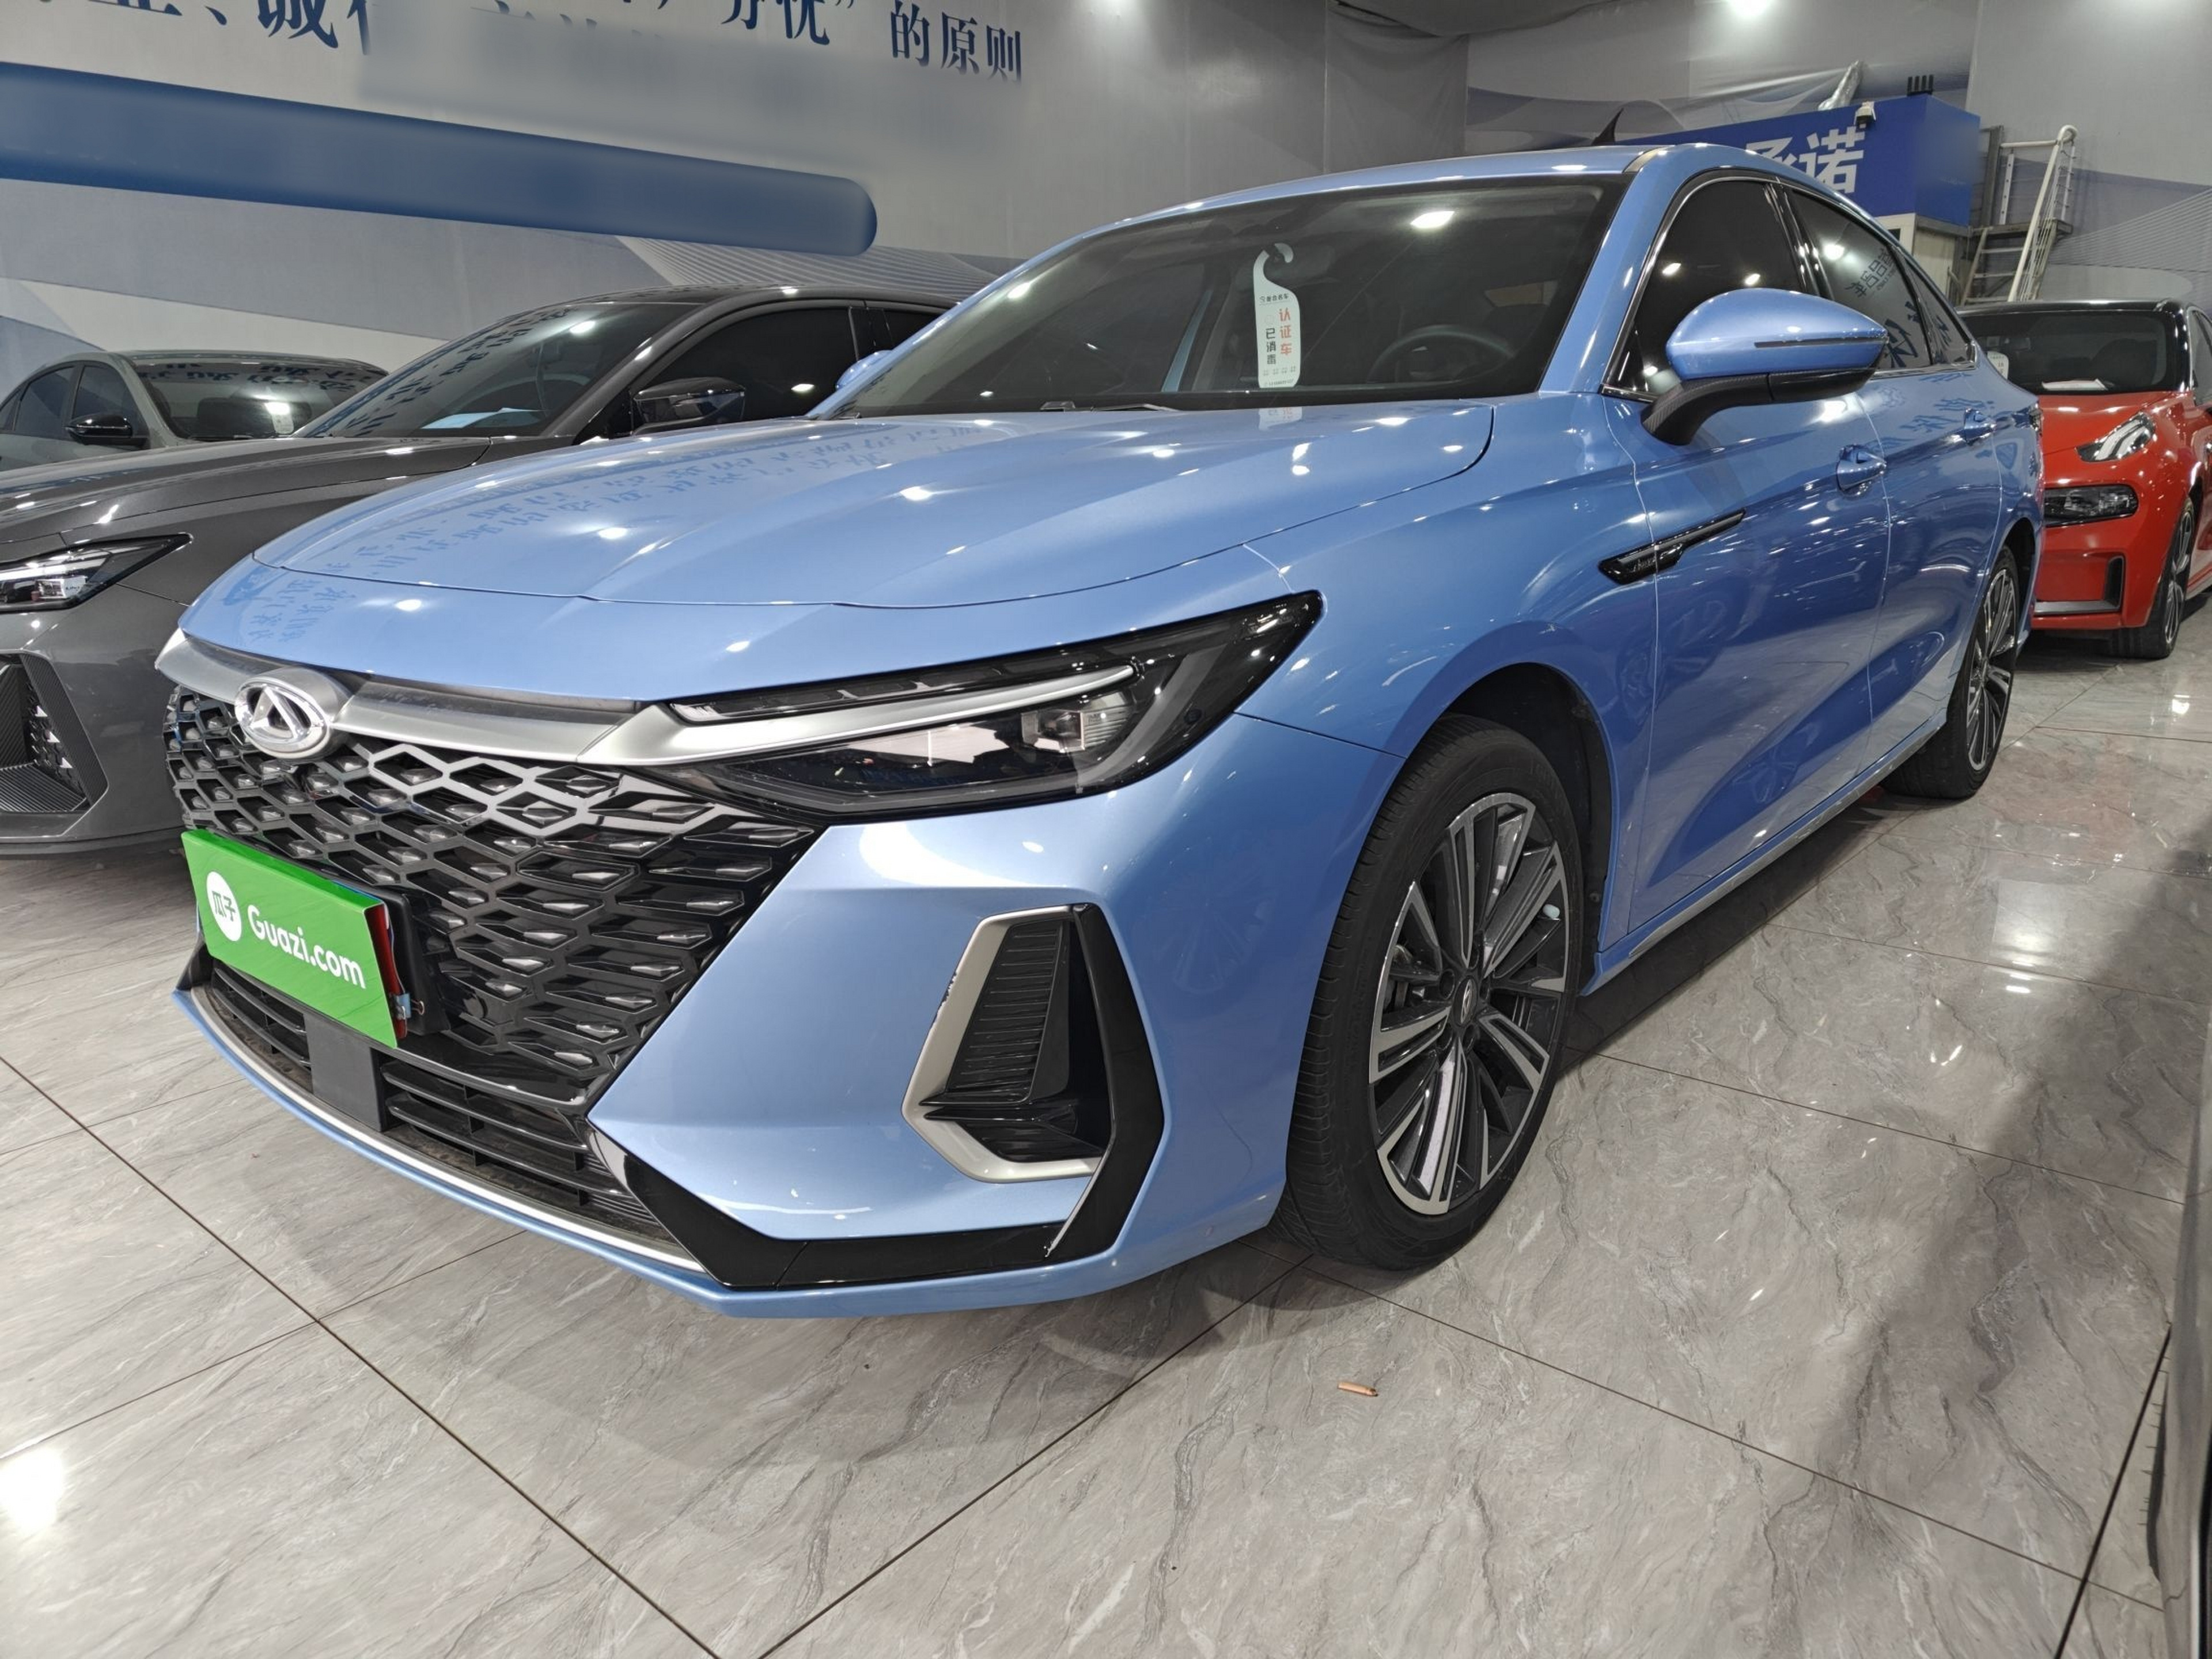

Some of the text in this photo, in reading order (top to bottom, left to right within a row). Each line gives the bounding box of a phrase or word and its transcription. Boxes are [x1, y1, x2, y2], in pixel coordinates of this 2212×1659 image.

[1279, 307, 1291, 355] 认证车
[211, 890, 236, 922] 瓜子
[247, 904, 367, 989] Guazi.com
